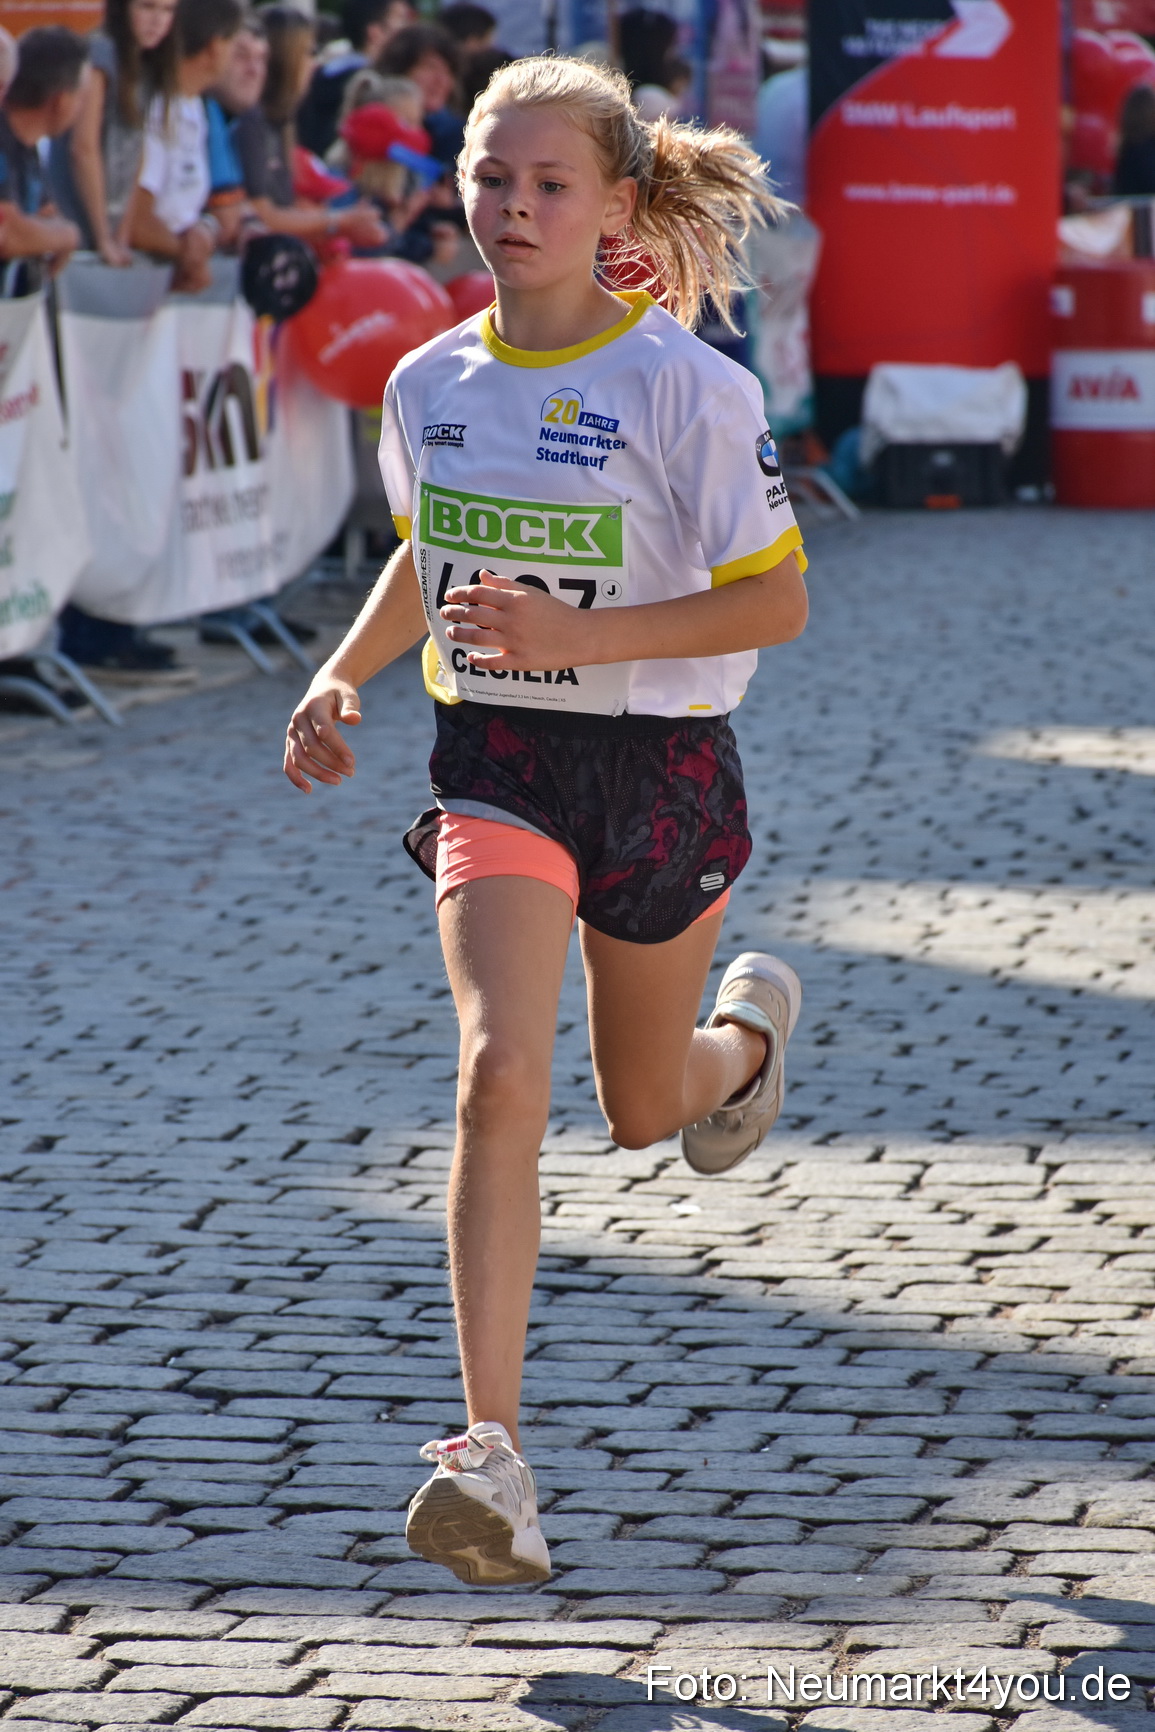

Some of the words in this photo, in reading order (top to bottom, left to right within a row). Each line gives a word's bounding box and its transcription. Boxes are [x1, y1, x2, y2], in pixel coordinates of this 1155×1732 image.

[544, 398, 580, 425] 20
[581, 414, 616, 430] JAHRE
[423, 424, 465, 440] BOCK
[539, 427, 628, 450] Neumarkter
[536, 447, 609, 471] Stadtlauf
[431, 496, 600, 556] BOCK
[436, 562, 597, 630] 47
